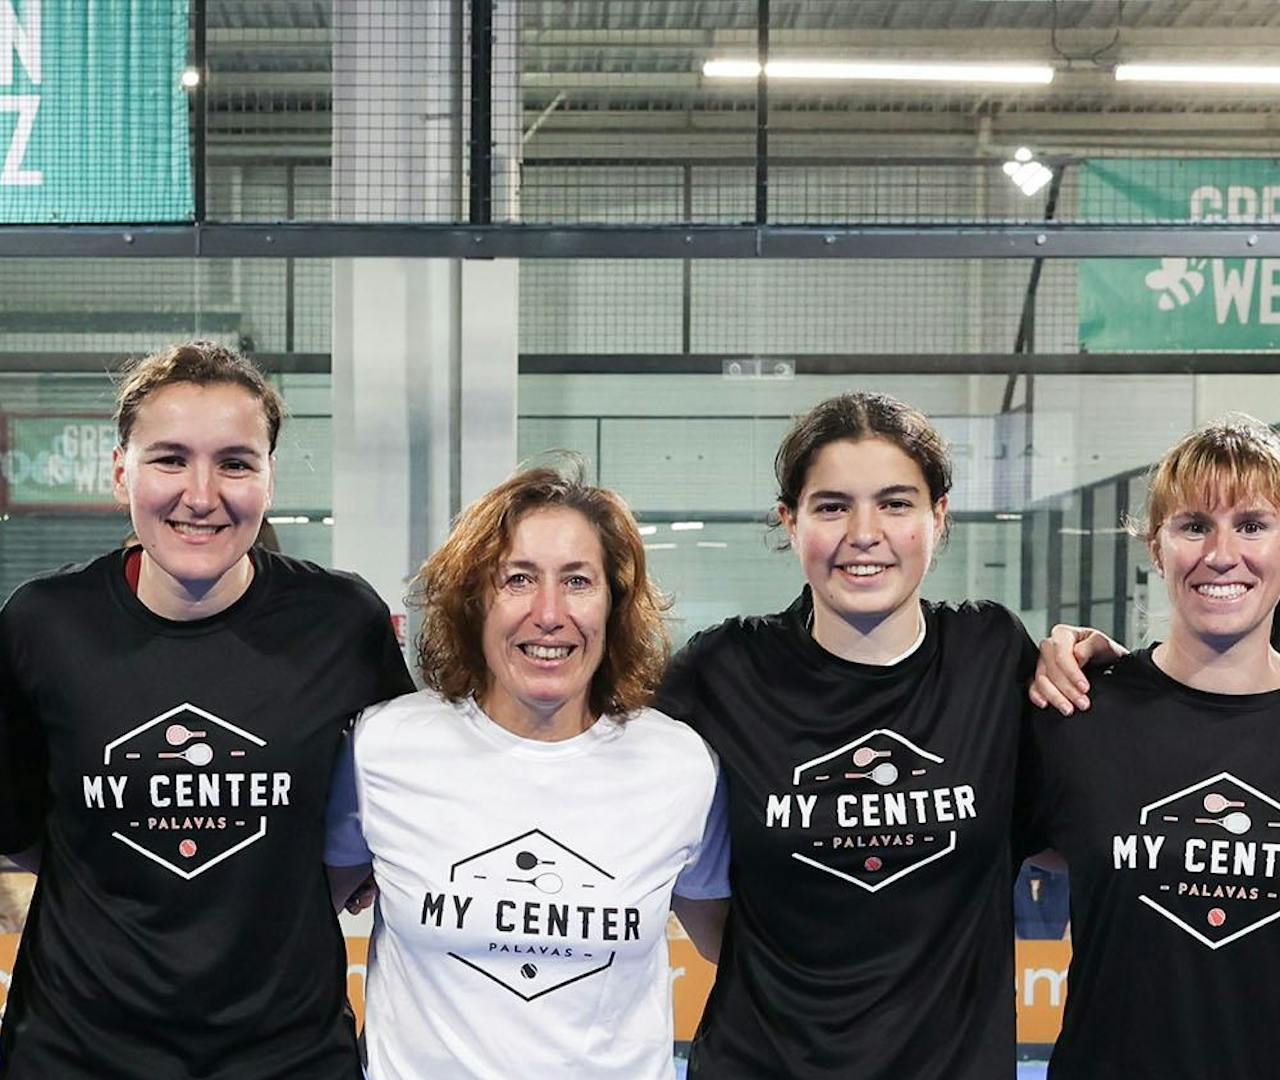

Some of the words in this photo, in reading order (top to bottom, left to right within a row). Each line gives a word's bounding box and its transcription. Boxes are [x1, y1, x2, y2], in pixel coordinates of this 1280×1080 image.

[82, 776, 125, 808] MY
[150, 771, 291, 807] CENTER
[766, 794, 817, 828] MY
[837, 784, 977, 826] CENTER
[148, 816, 227, 830] PALAVAS
[833, 833, 915, 849] PALAVAS
[1112, 835, 1165, 871] MY
[1178, 883, 1258, 900] PALAVAS
[421, 892, 473, 929] MY
[495, 902, 640, 941] CENTER
[489, 941, 572, 958] PALAVAS
